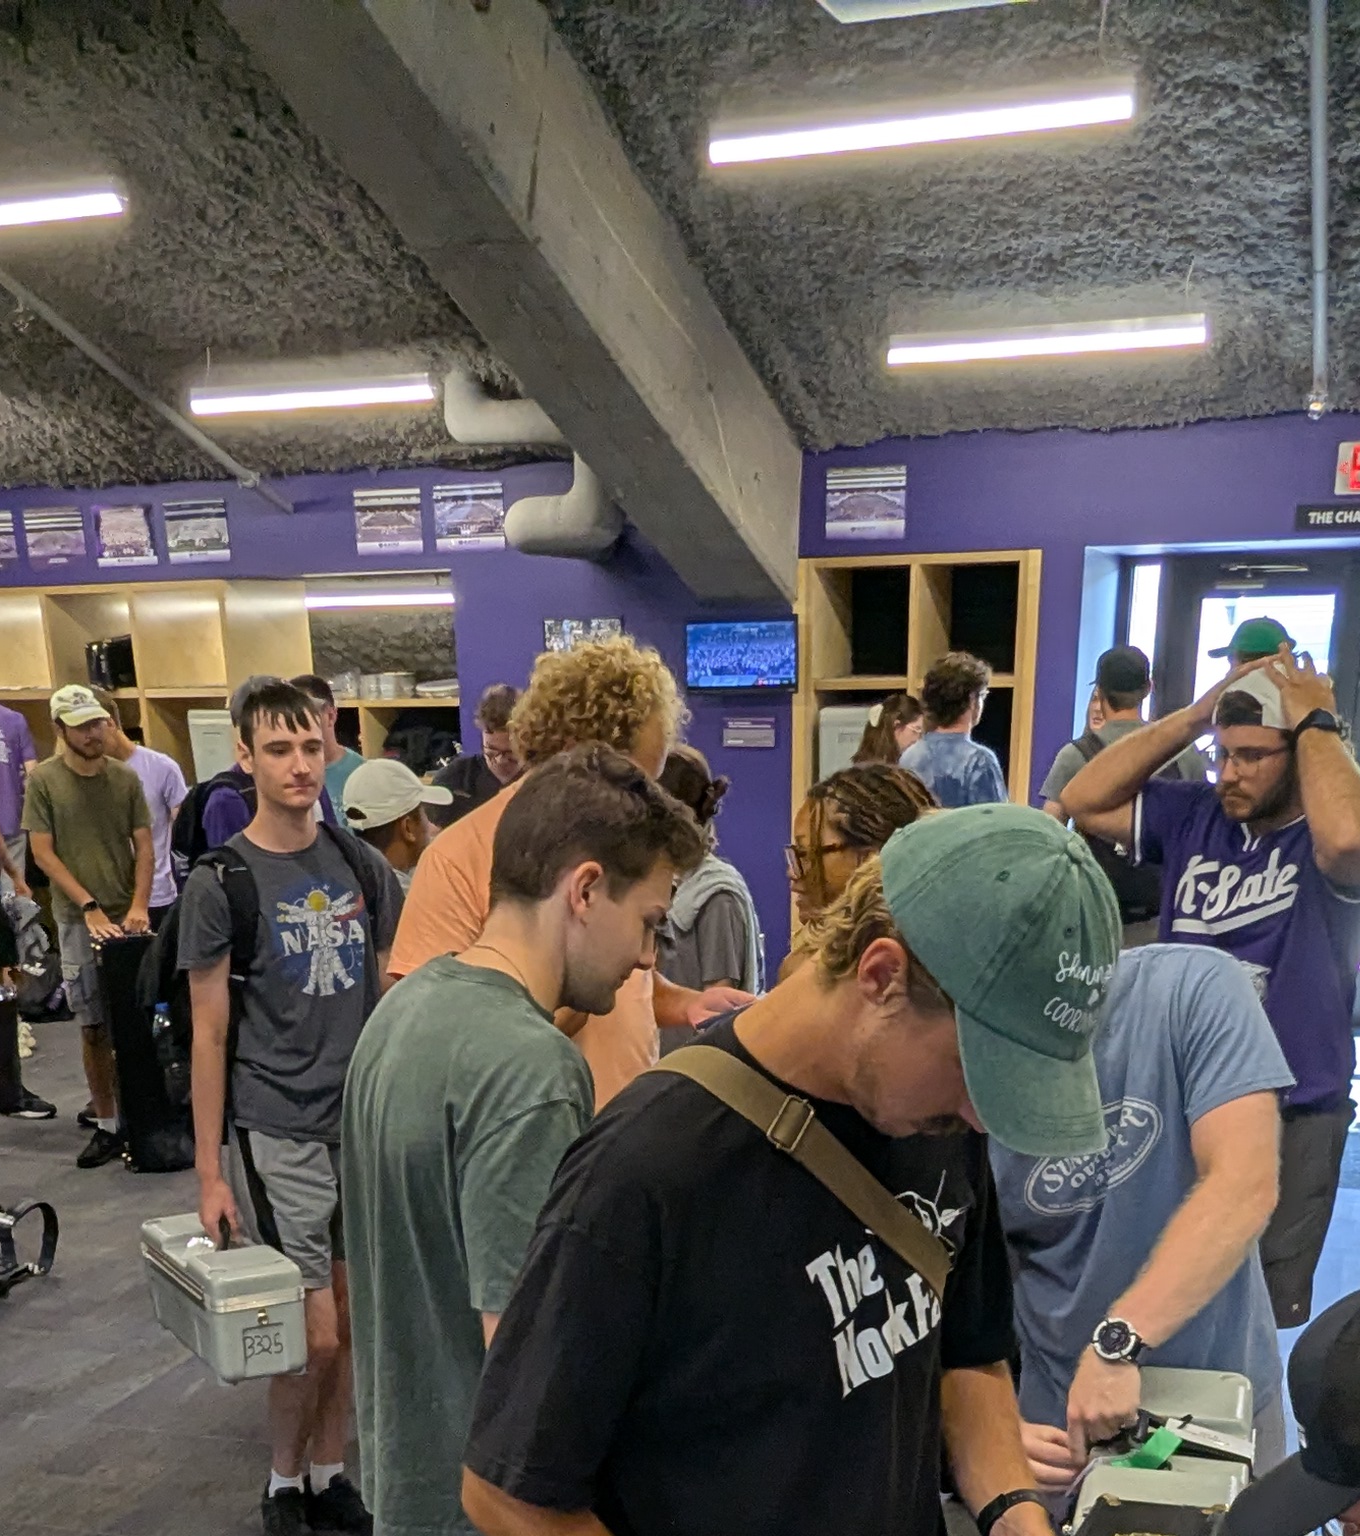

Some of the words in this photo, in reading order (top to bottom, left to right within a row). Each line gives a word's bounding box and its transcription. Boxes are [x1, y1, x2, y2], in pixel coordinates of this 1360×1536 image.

[1308, 511, 1333, 524] THE
[1174, 847, 1299, 922] K-State
[280, 920, 365, 956] NASA
[805, 1244, 884, 1330] The
[243, 1332, 283, 1360] B325
